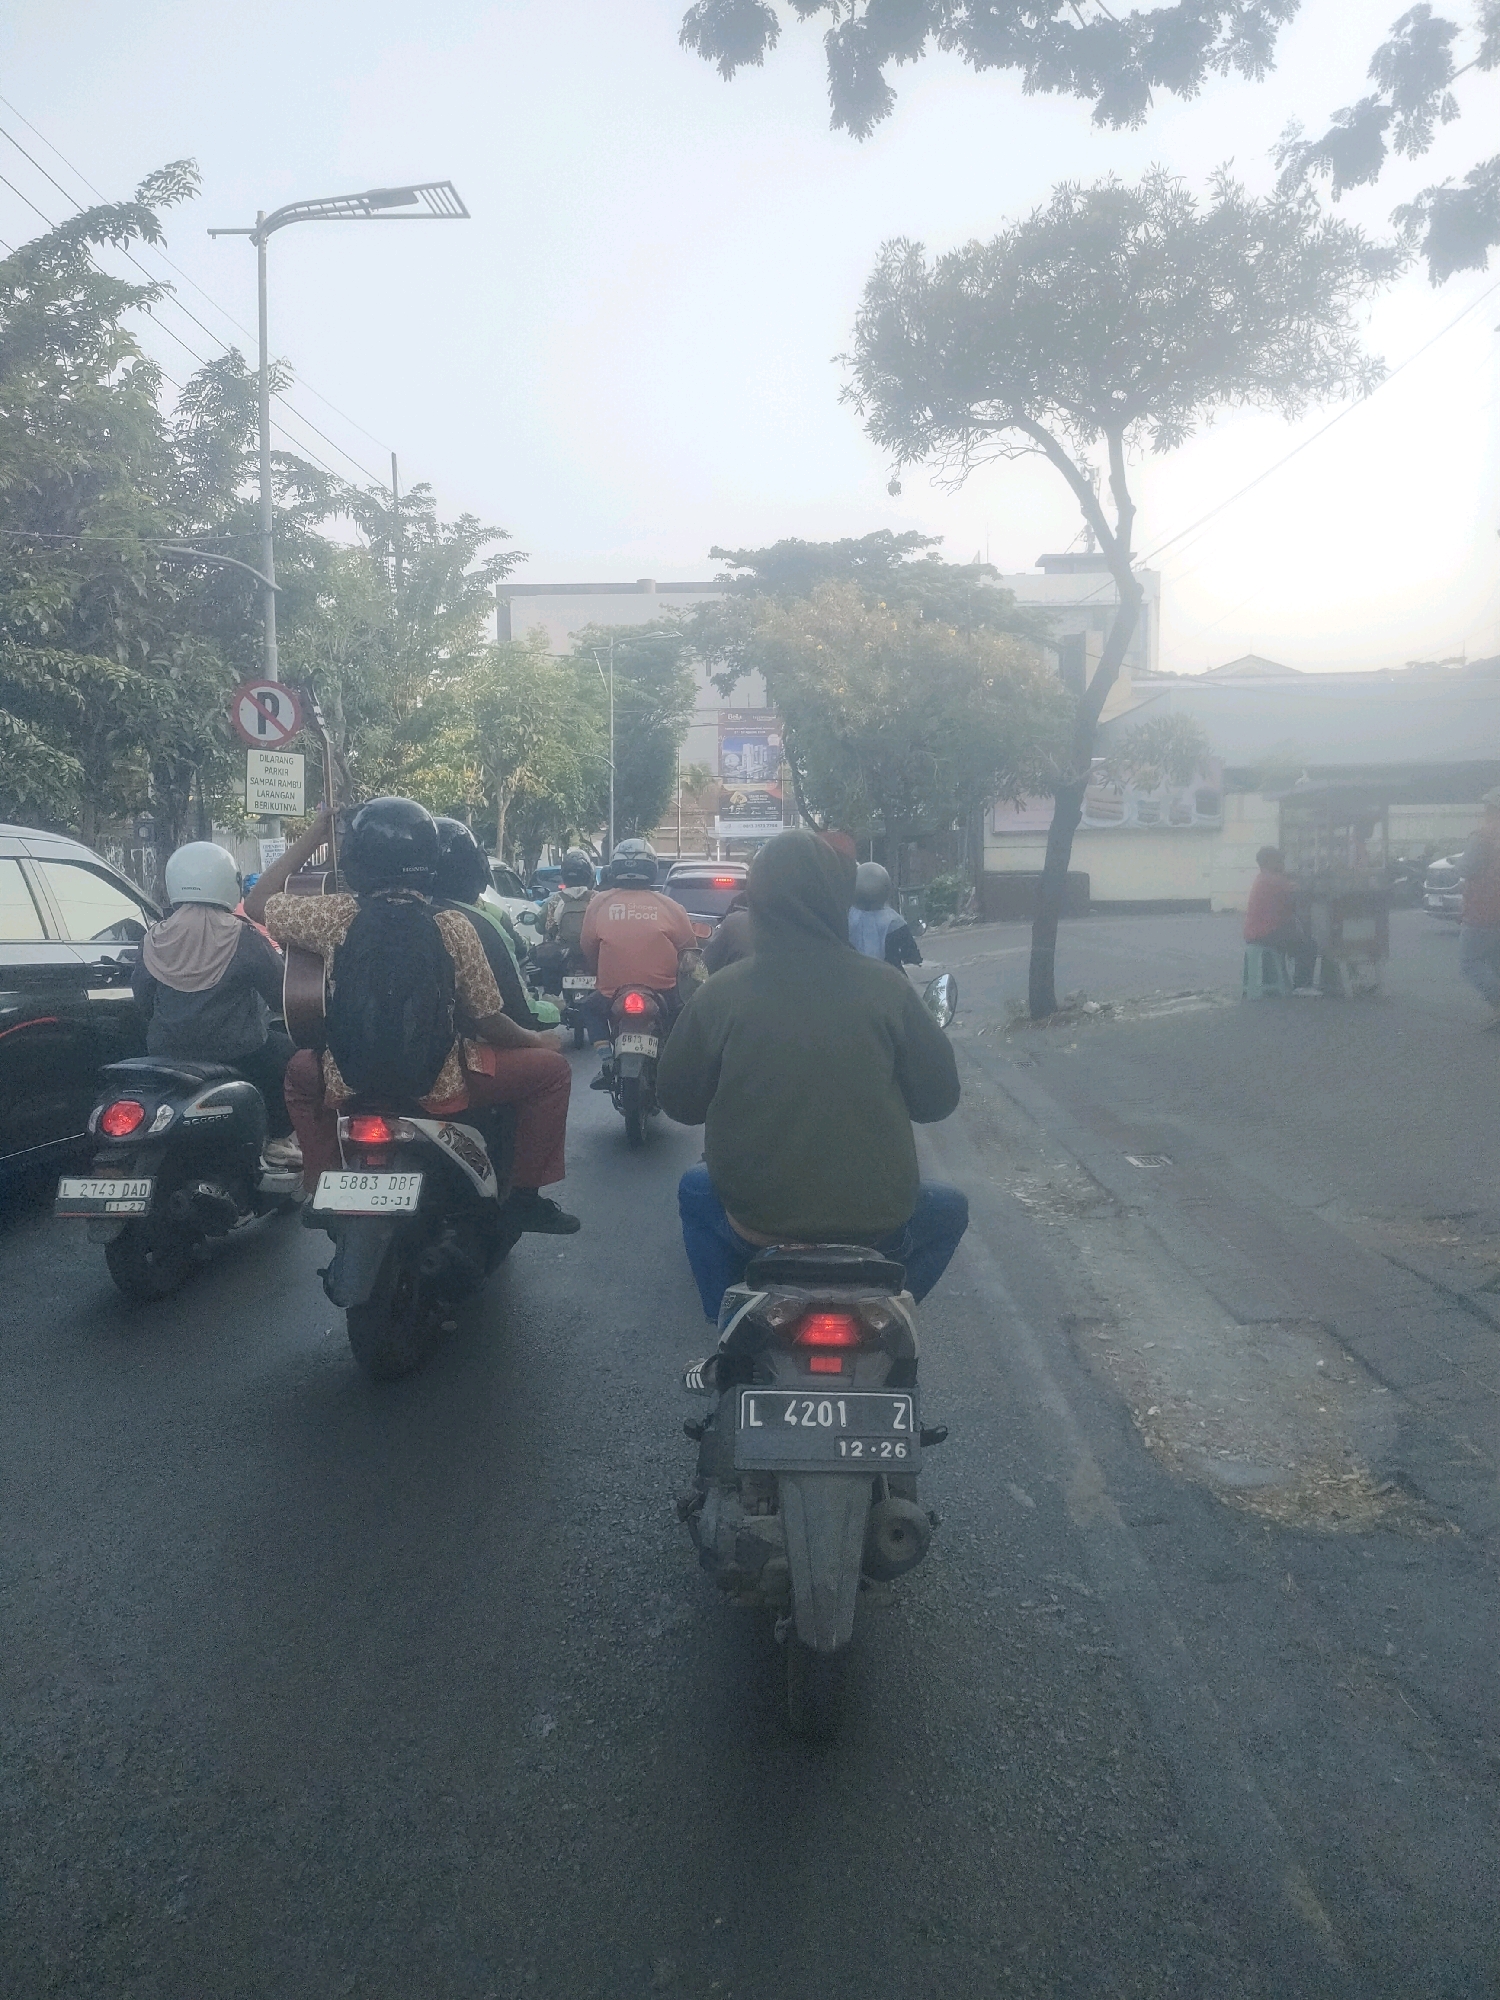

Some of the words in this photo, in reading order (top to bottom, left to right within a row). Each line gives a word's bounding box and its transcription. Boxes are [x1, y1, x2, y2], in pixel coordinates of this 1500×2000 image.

[259, 754, 294, 765] DILARANG
[264, 766, 289, 776] PARKIR
[250, 777, 276, 787] SAMPAI
[278, 779, 302, 789] RAMBU
[256, 789, 295, 800] LARANGAN
[254, 800, 297, 811] BERIKUTNYA
[627, 910, 658, 921] Food
[323, 1175, 331, 1190] L
[339, 1175, 379, 1190] 5883
[388, 1176, 418, 1191] DBF
[63, 1182, 70, 1197] L
[80, 1183, 116, 1197] 2743
[122, 1183, 148, 1197] DAD
[749, 1399, 764, 1427] L
[784, 1399, 847, 1428] 4201
[893, 1402, 907, 1430] Z
